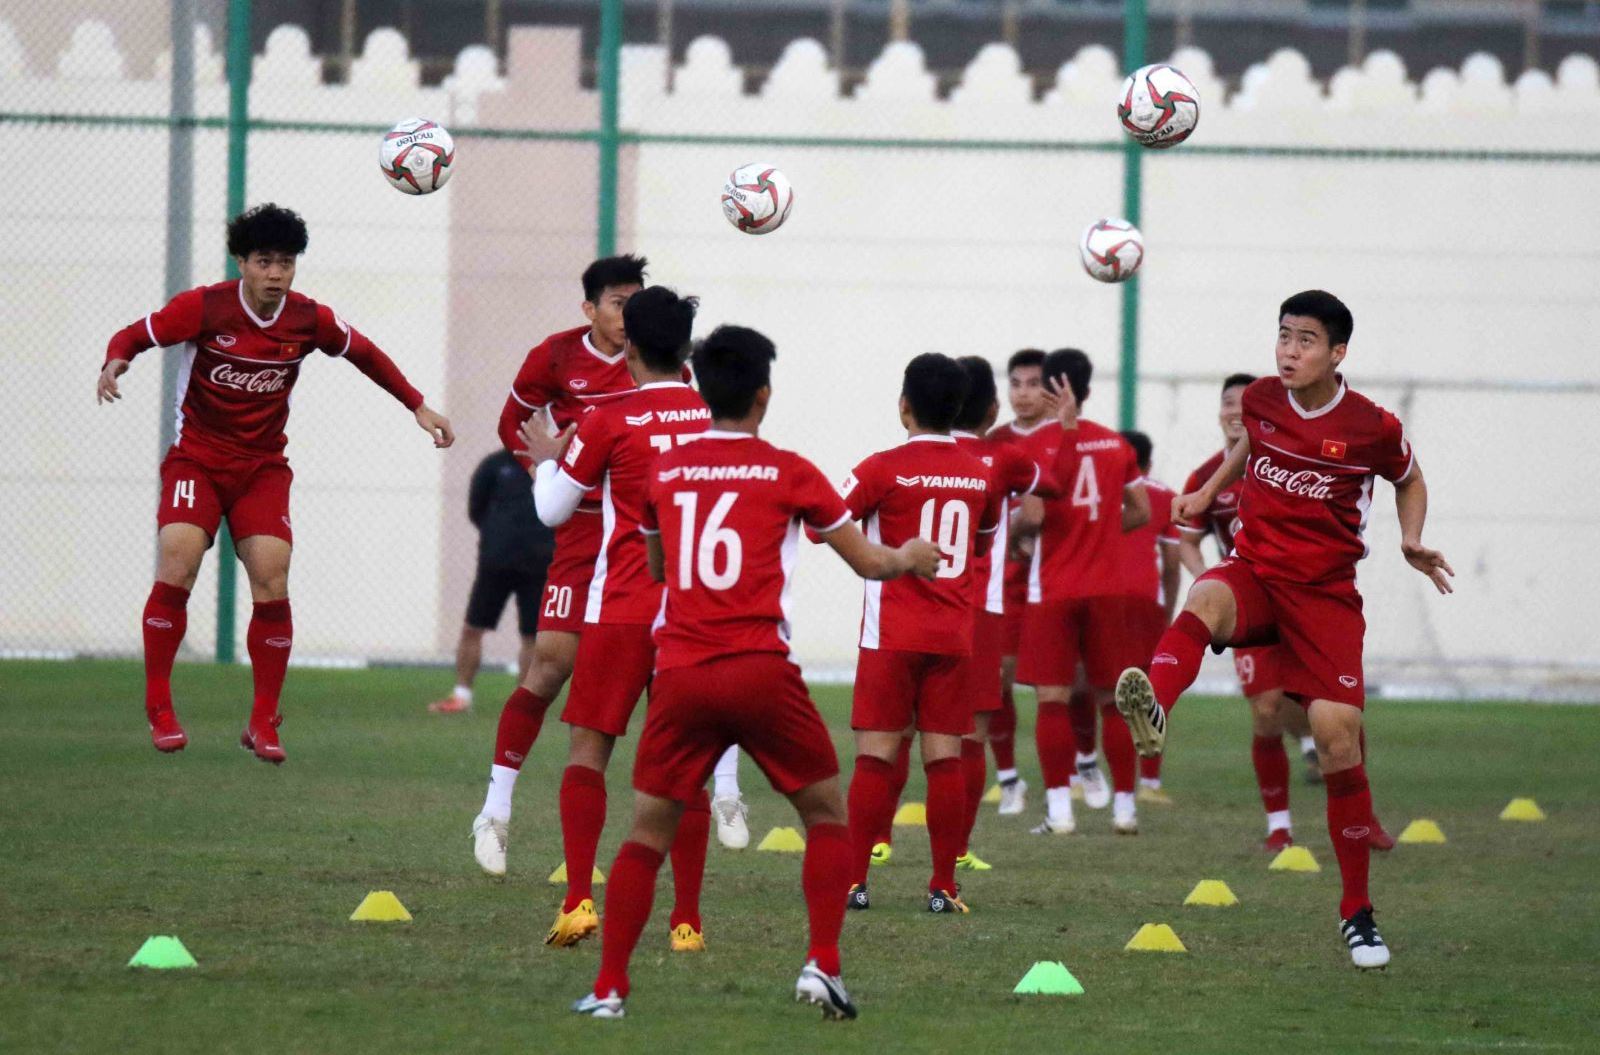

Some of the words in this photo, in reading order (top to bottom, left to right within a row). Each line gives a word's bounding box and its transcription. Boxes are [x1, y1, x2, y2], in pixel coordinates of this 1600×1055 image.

[396, 132, 434, 147] molten
[210, 363, 289, 393] Coca-Cola
[681, 465, 779, 481] YANMAR
[920, 475, 986, 491] YANMAR
[1072, 455, 1102, 522] 4
[1254, 456, 1337, 499] Coca-Cola
[173, 480, 195, 508] 14
[673, 492, 742, 591] 16
[919, 498, 970, 579] 19
[544, 585, 572, 618] 20
